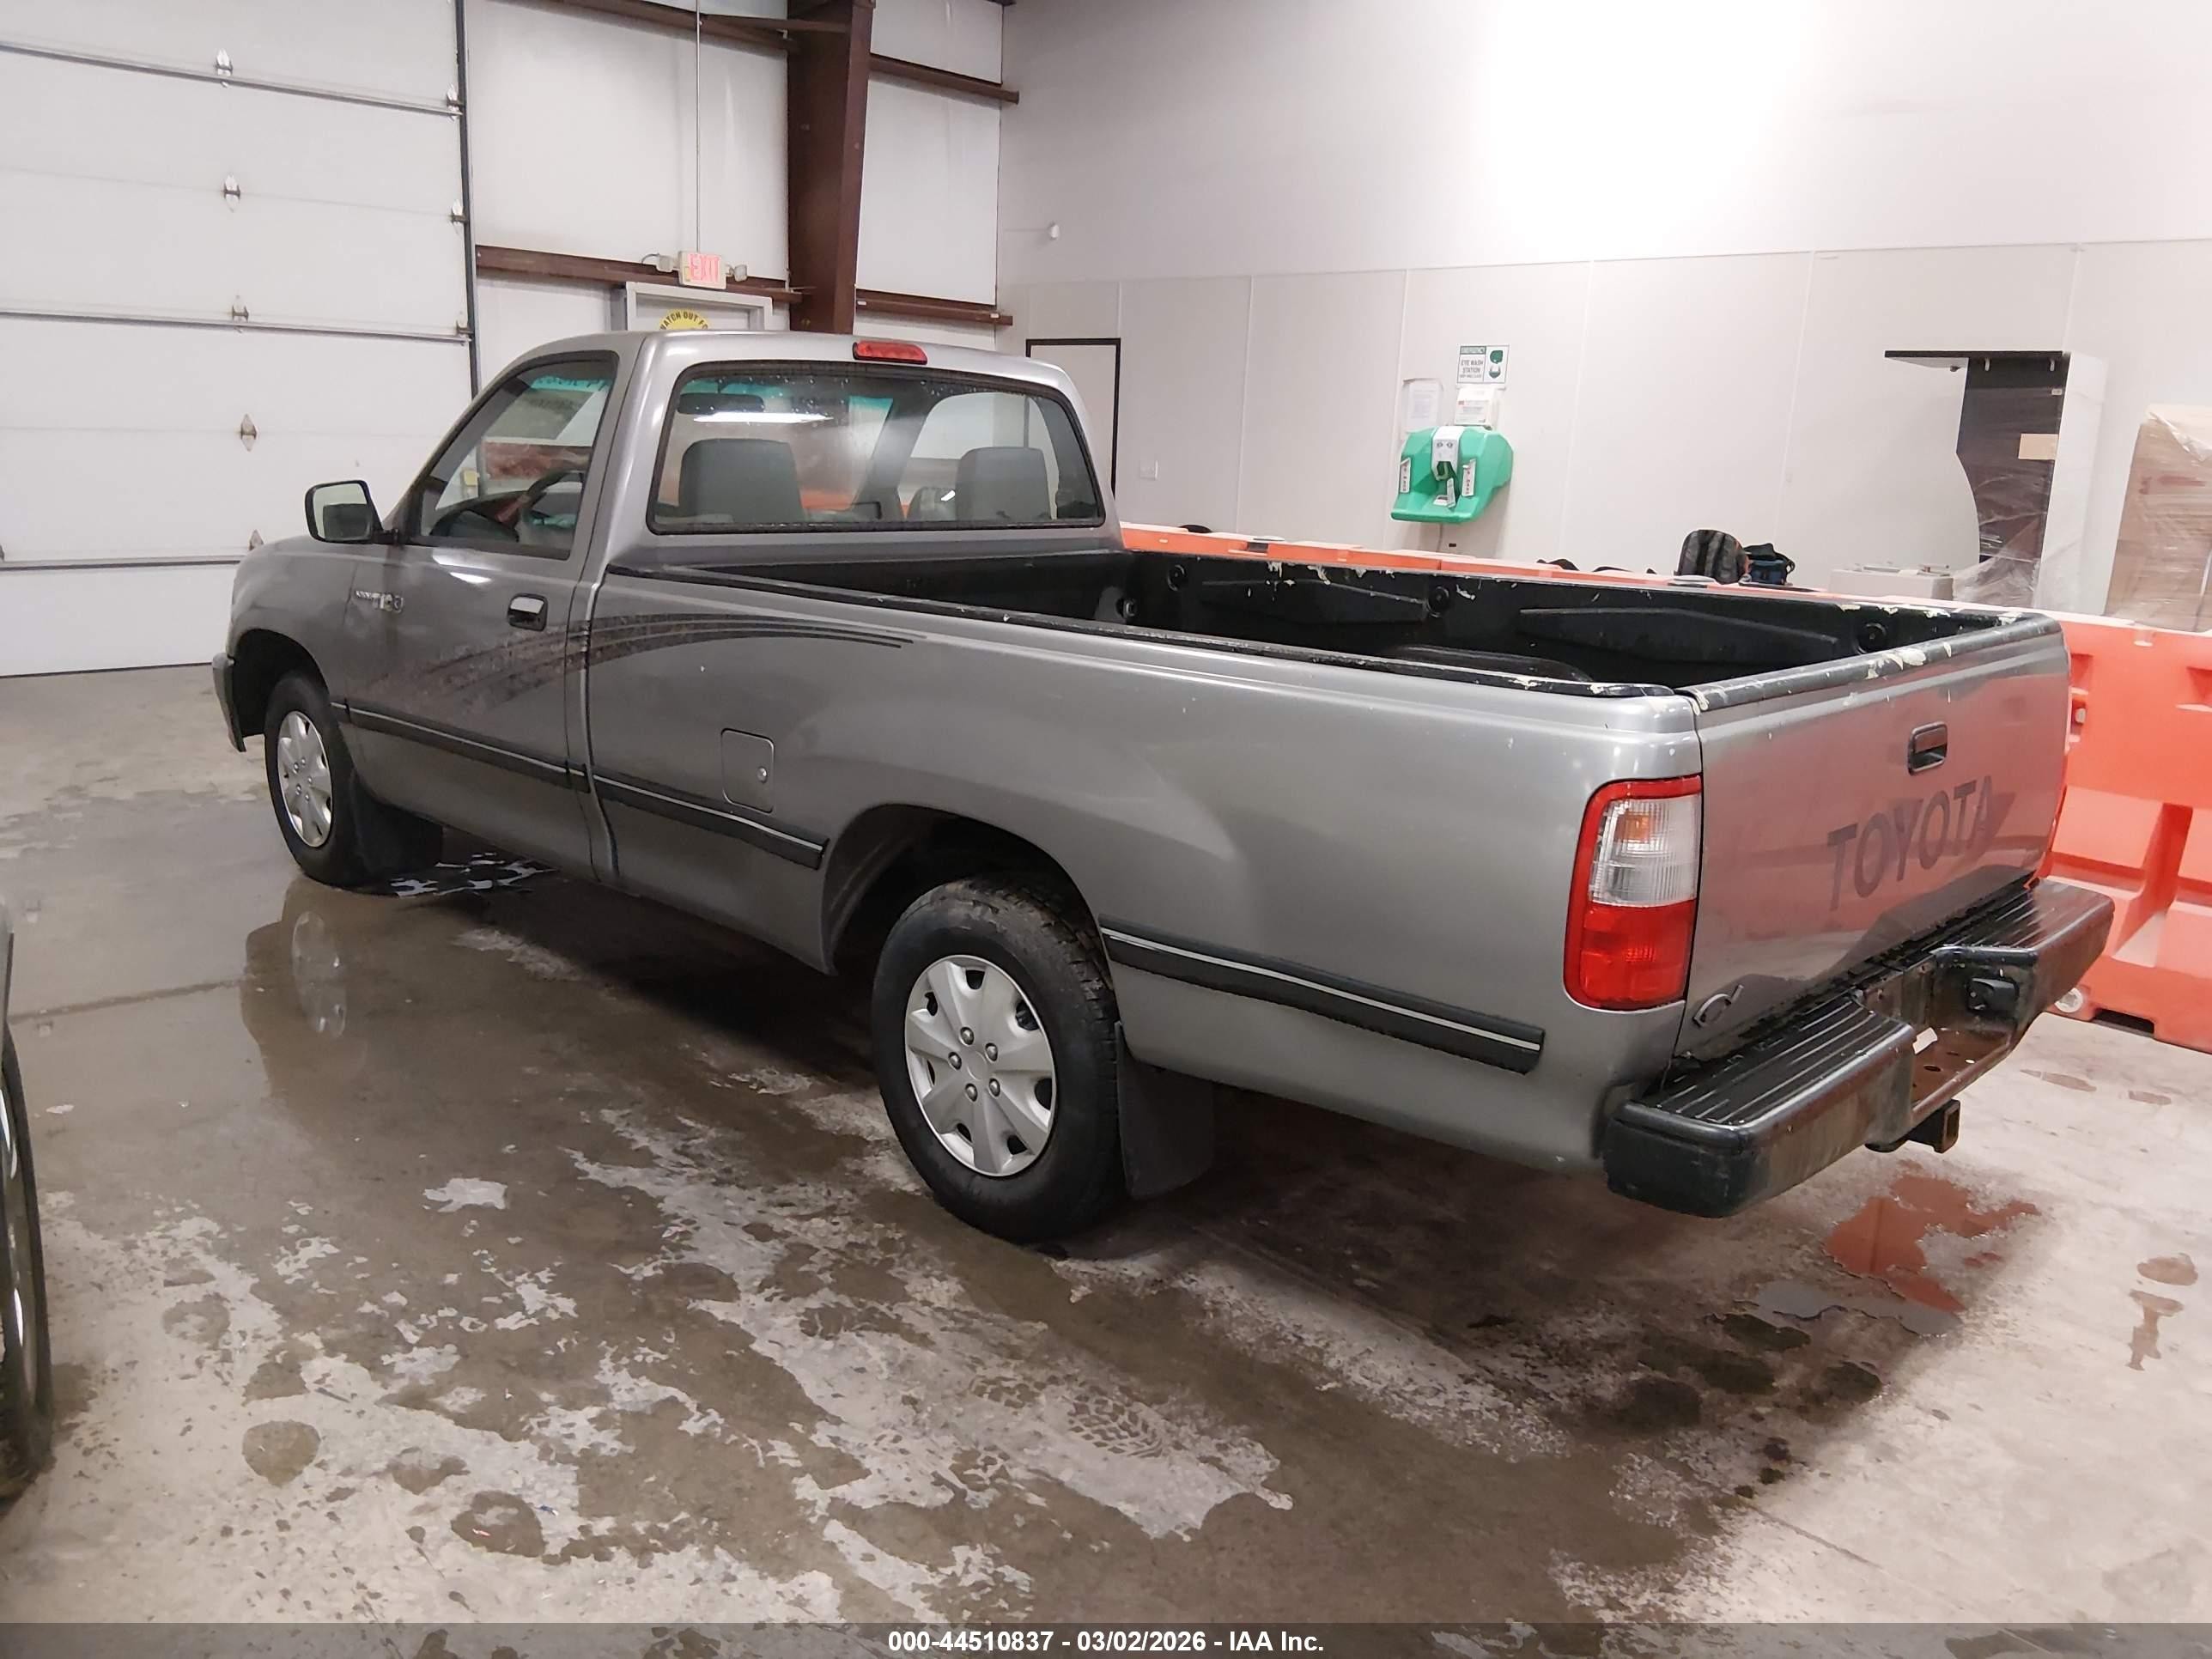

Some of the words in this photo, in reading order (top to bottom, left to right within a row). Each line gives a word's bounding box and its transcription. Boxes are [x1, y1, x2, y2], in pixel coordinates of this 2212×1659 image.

[690, 253, 720, 283] EXIT
[683, 311, 699, 322] OUT
[1826, 775, 1994, 912] TOYOTA
